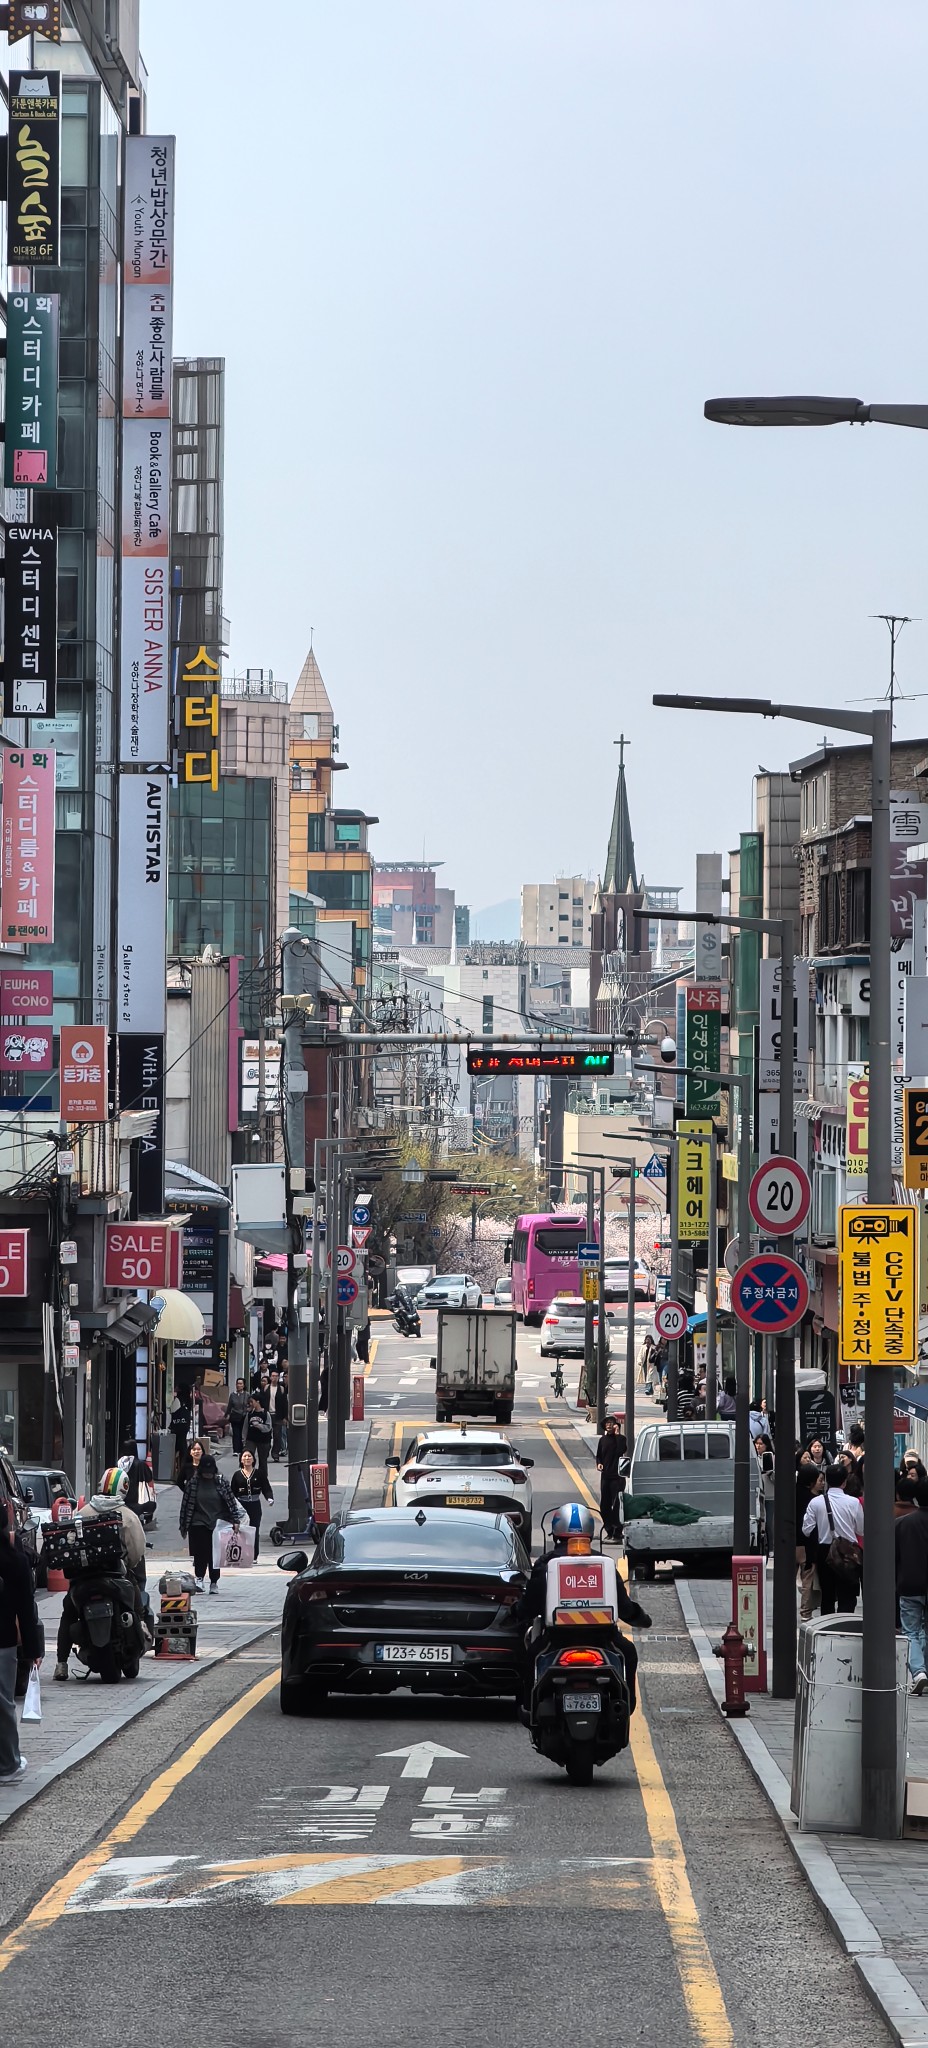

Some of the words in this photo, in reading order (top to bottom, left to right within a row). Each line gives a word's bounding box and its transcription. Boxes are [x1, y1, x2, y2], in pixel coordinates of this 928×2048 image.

[11, 110, 30, 118] Cartoon
[34, 110, 46, 118] Book
[46, 110, 57, 118] cafe
[149, 146, 169, 269] 청년밥상문간
[134, 207, 145, 236] Youth
[39, 243, 54, 256] 6F
[132, 240, 144, 278] Mungan
[13, 297, 53, 313] 이화
[149, 316, 166, 401] 좋은사람들
[21, 315, 43, 444] 스터디카페
[8, 528, 54, 540] EWHA
[149, 513, 162, 538] Cafe
[20, 545, 42, 674] 스터디센터
[144, 567, 164, 632] SISTER
[144, 639, 163, 694] ANNA
[182, 645, 221, 792] 스터디
[9, 753, 49, 769] 이화
[145, 781, 162, 884] AUTISTAR
[892, 810, 921, 836] 雪
[7, 925, 49, 937] 플랜에이
[121, 944, 133, 982] gallery
[4, 979, 39, 990] EWHA
[12, 995, 49, 1007] CONO
[688, 990, 720, 1008] 사주
[122, 1012, 131, 1023] 2F
[142, 1046, 158, 1088] With
[766, 1180, 794, 1211] 20
[109, 1235, 163, 1253] SALE
[690, 1240, 701, 1248] 2F
[121, 1258, 152, 1280] 50
[851, 1252, 872, 1286] 불법
[885, 1251, 904, 1302] CCTV
[742, 1286, 798, 1300] 주정차금지
[664, 1312, 679, 1329] 20
[884, 1307, 905, 1355] 단속중
[806, 1416, 831, 1430] 근력
[565, 1574, 598, 1589] 에스원
[560, 1599, 590, 1608] SECOM
[419, 1648, 449, 1660] 6515
[573, 1700, 598, 1710] 7663
